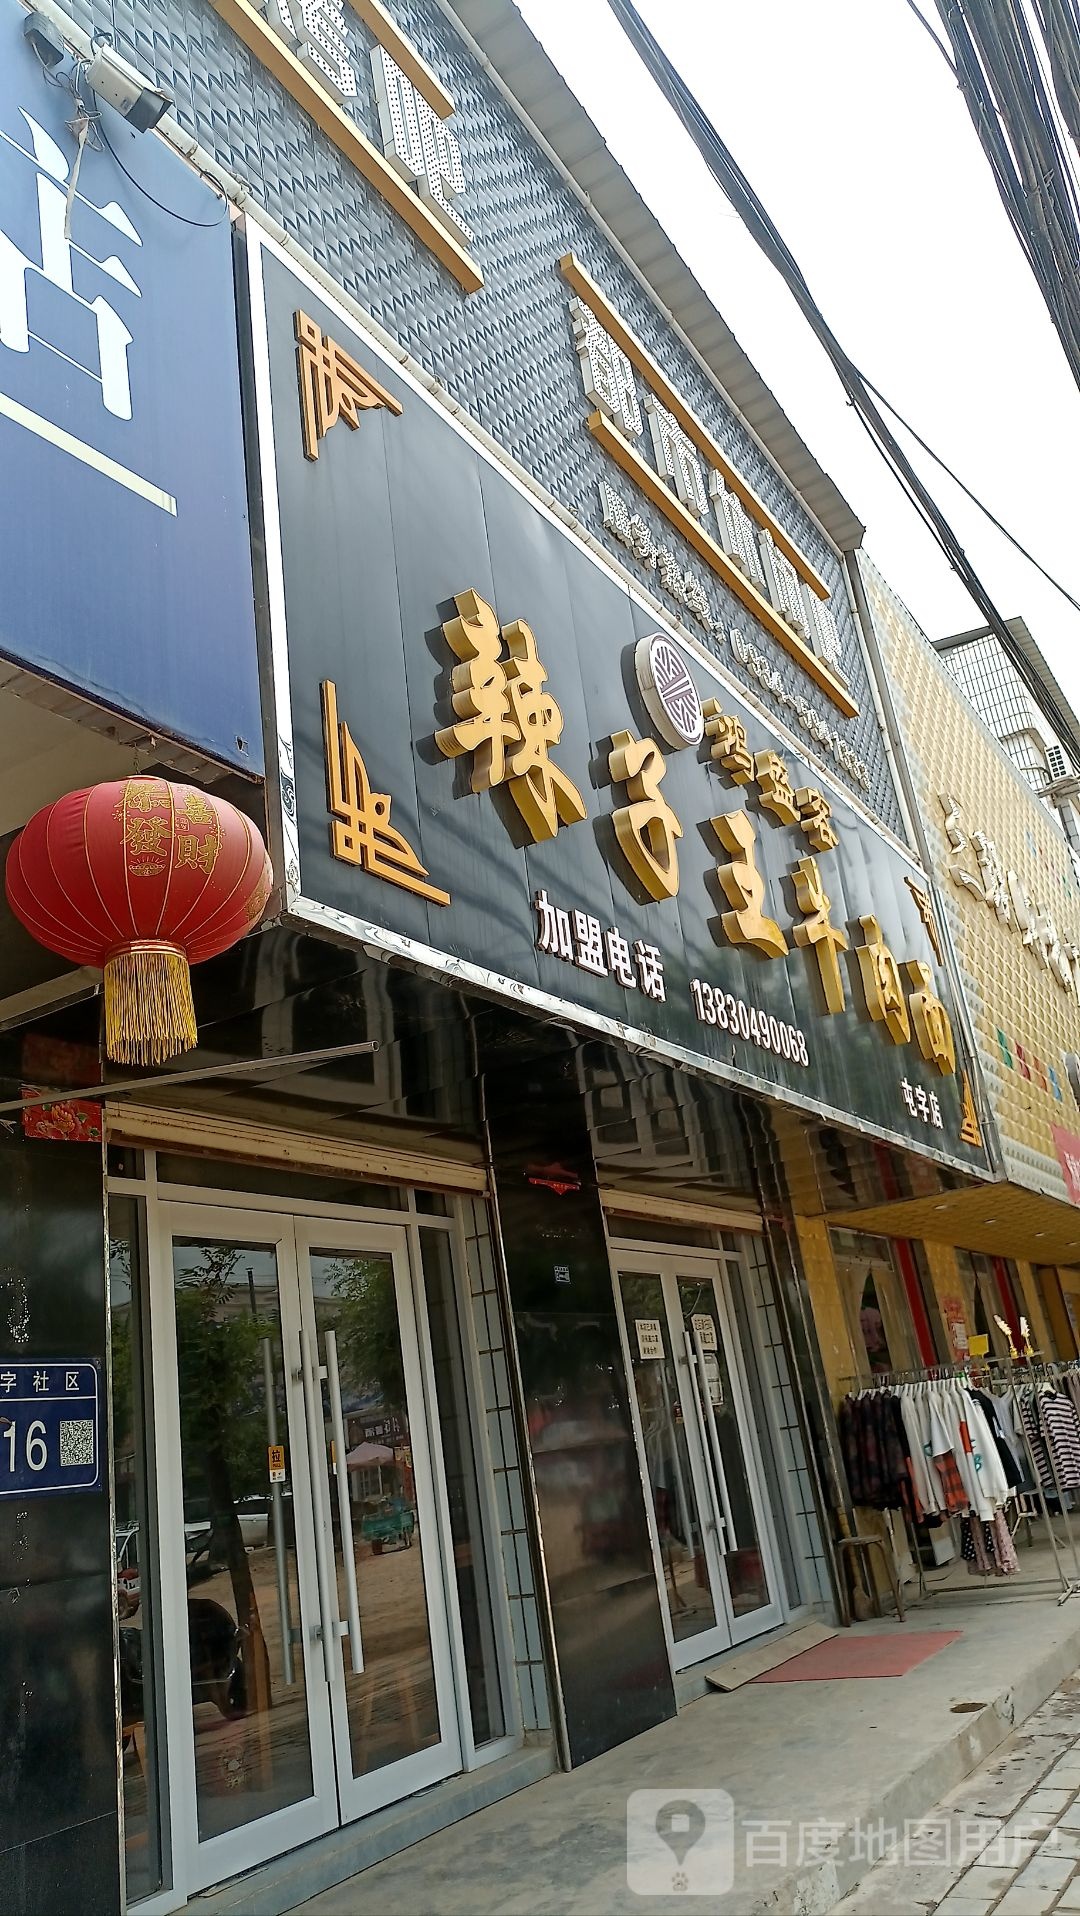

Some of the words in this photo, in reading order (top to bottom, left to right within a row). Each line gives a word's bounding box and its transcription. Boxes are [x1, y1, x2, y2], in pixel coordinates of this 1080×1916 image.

[434, 588, 956, 1076] 辣子王牛肉面
[701, 697, 839, 852] 鸿盛客
[535, 889, 666, 1003] 加盟电话
[690, 978, 809, 1067] 13830490068
[901, 1077, 944, 1129] 屯字店
[272, 1450, 281, 1463] 拉
